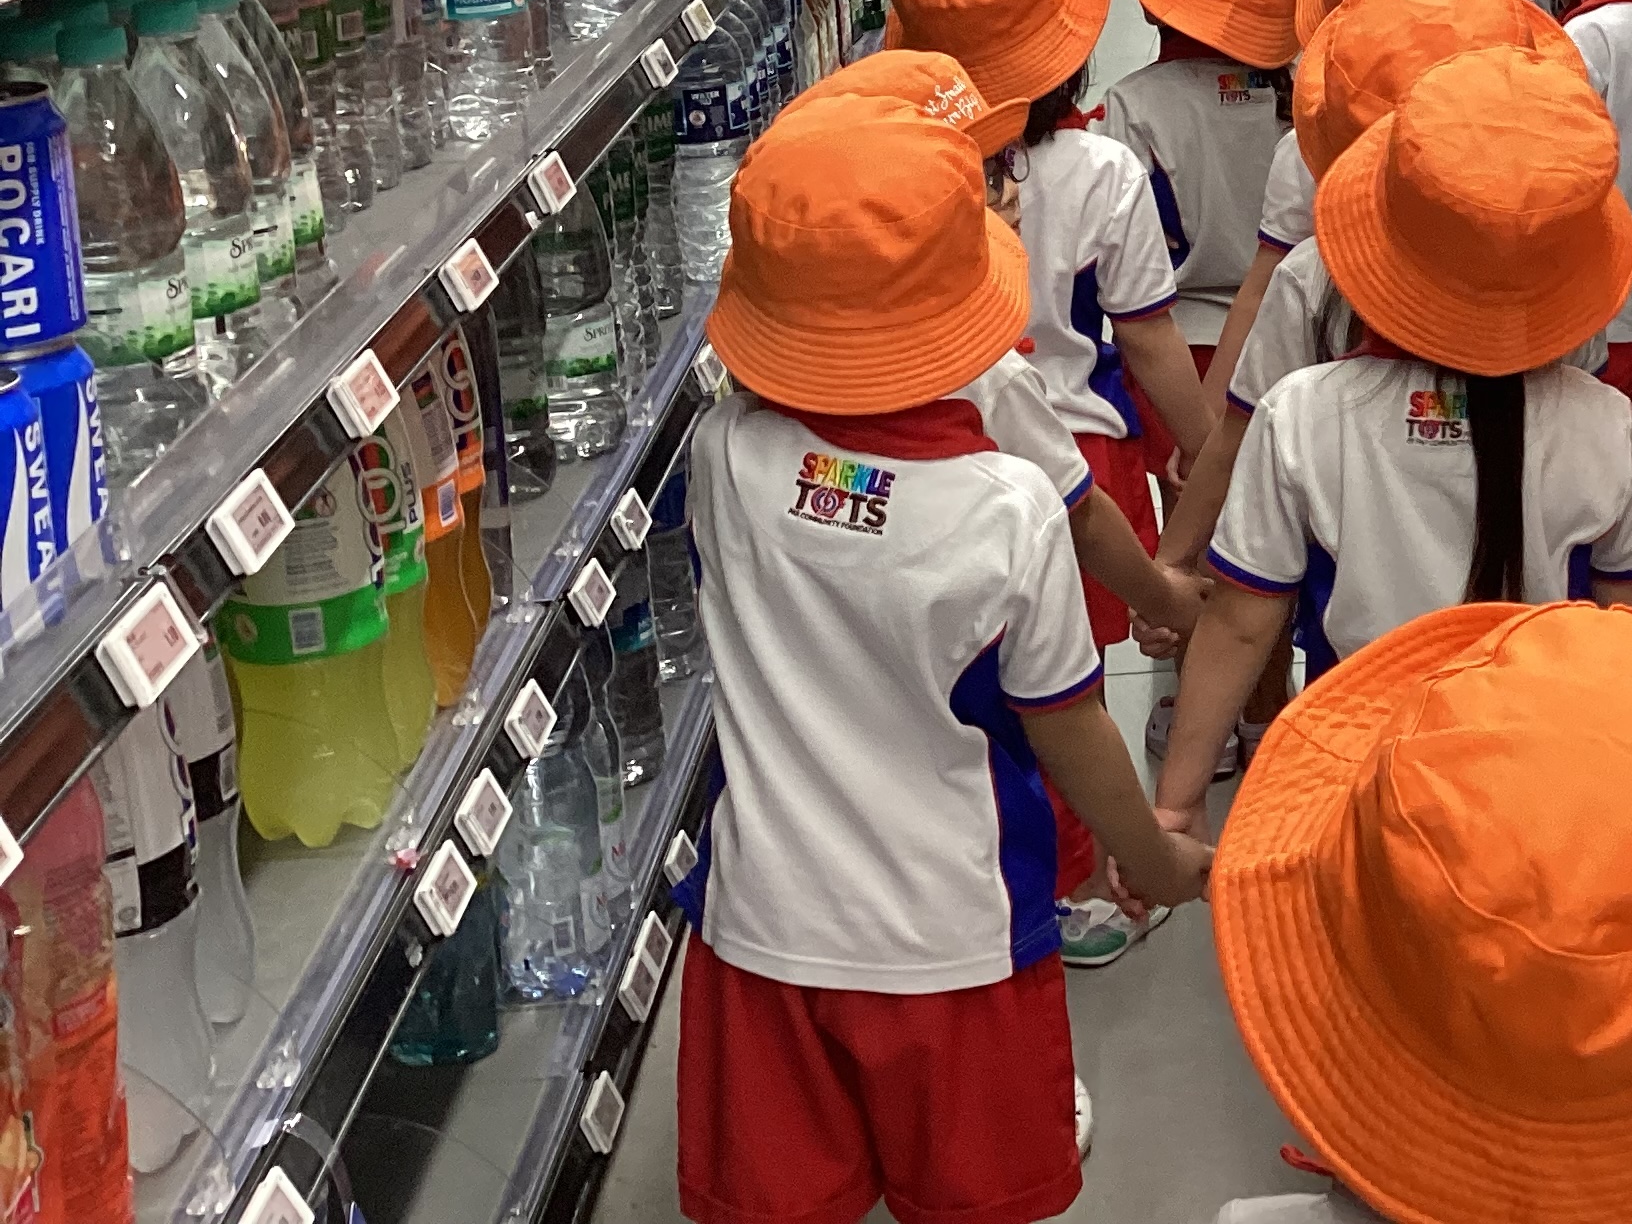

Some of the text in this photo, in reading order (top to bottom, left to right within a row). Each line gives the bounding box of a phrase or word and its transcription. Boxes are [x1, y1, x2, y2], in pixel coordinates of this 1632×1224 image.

[0, 143, 42, 341] POCARI
[799, 451, 896, 499] SPARKLE
[796, 478, 888, 528] TOTS
